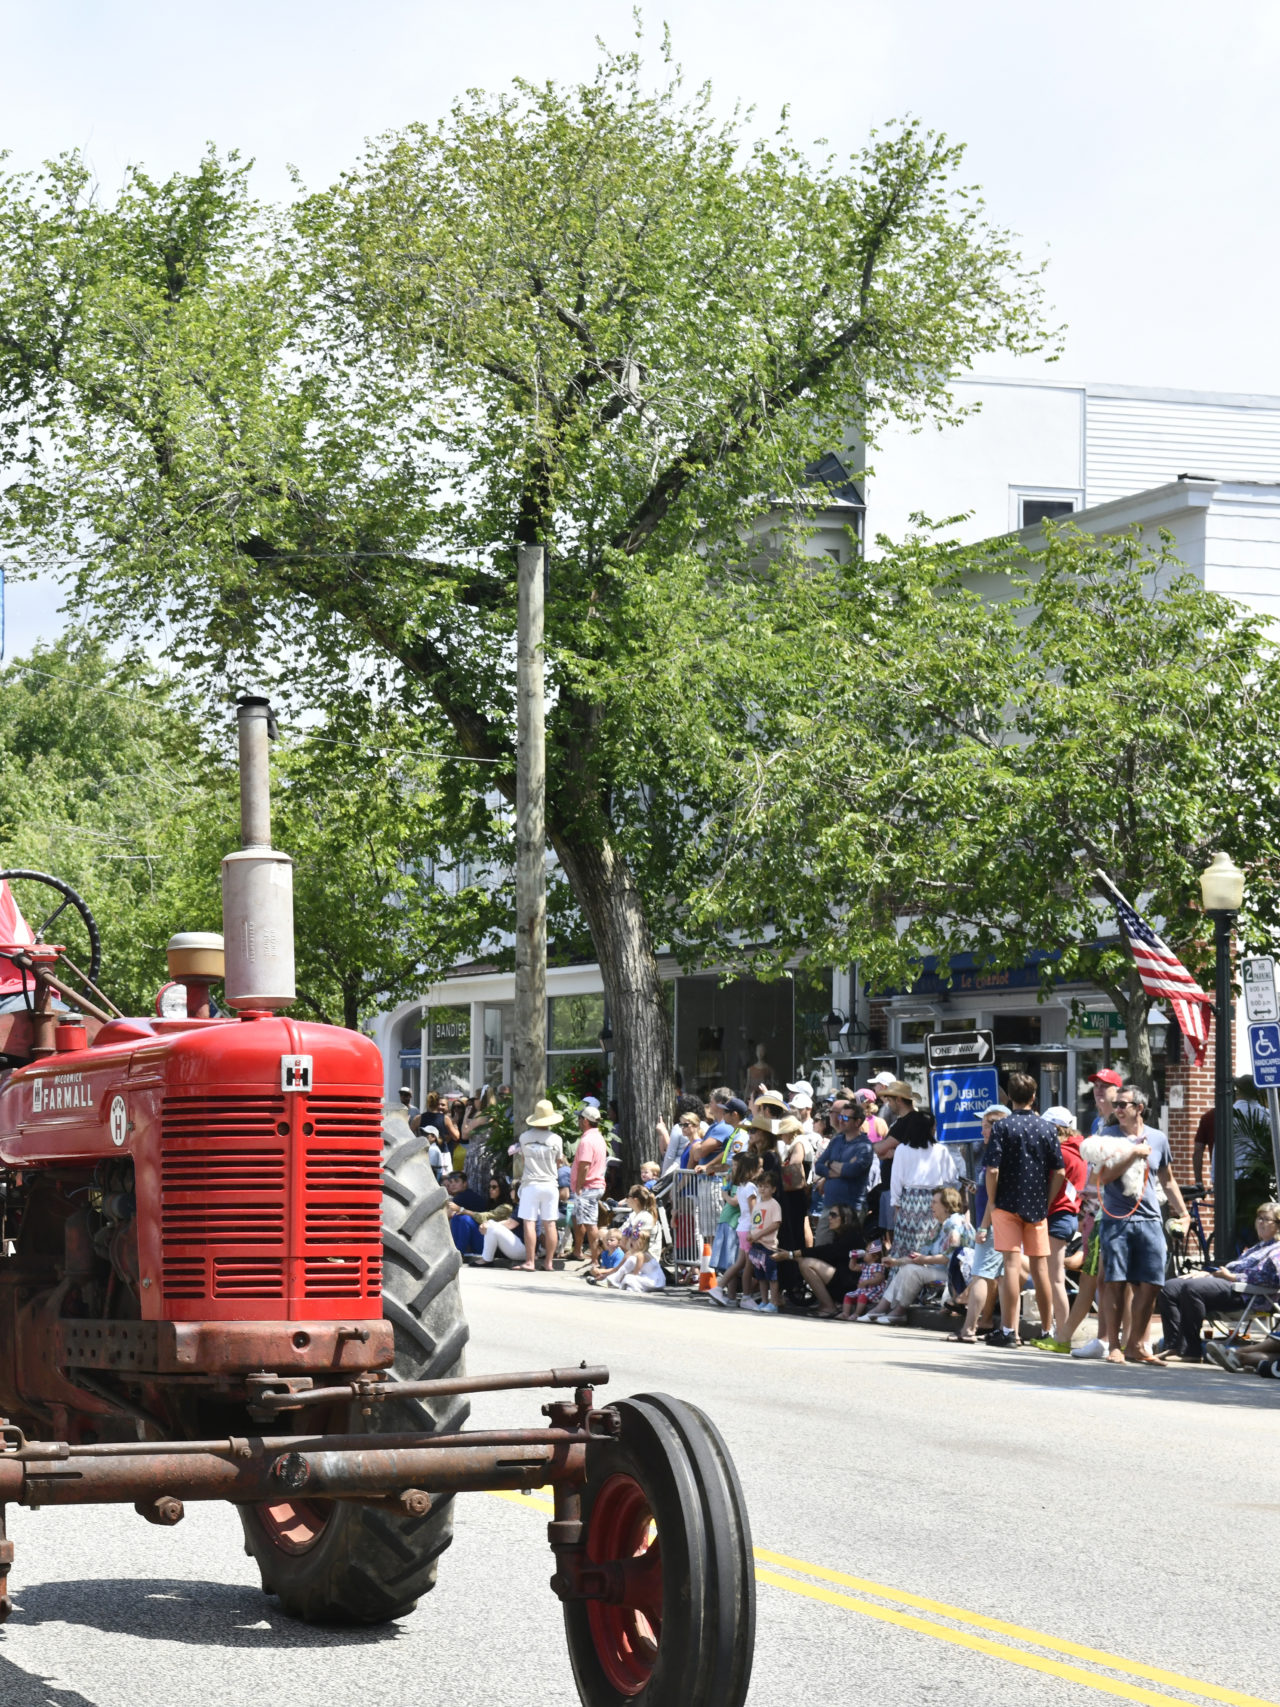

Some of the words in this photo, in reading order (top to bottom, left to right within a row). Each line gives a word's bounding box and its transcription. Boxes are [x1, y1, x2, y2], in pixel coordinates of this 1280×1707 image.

[1245, 965, 1252, 980] 2
[1254, 972, 1271, 980] PARKING
[1091, 1014, 1109, 1028] Wall
[436, 1023, 467, 1038] BANDIER
[935, 1046, 952, 1055] ONE
[958, 1044, 975, 1053] WAY
[43, 1084, 93, 1111] FARMALL
[115, 1115, 122, 1140] H
